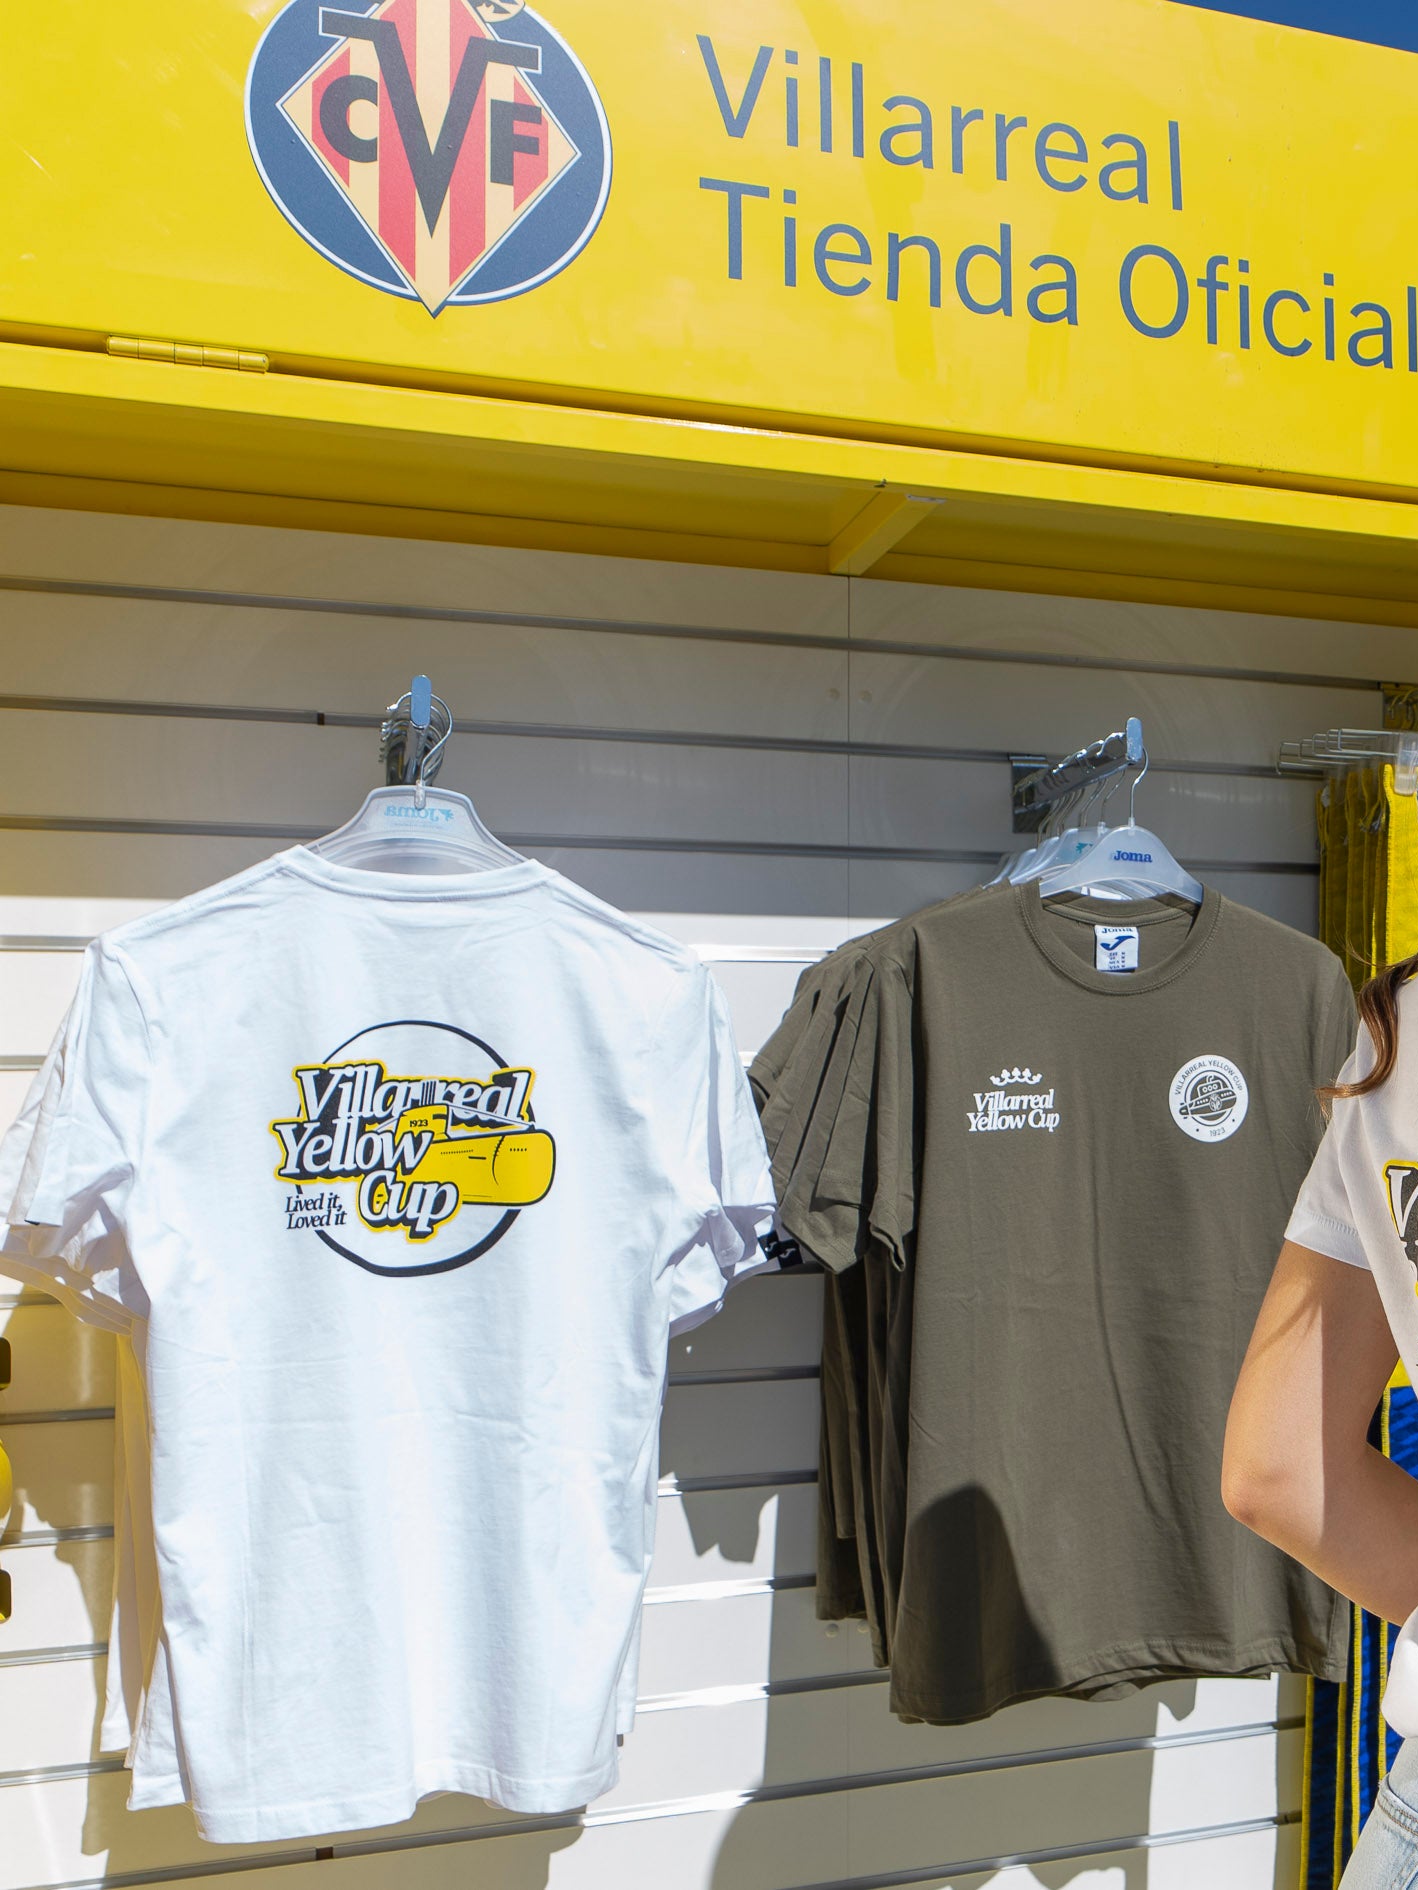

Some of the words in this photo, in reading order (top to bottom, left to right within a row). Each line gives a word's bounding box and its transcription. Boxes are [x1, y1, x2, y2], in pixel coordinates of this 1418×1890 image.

[695, 33, 1183, 211] Villarreal
[699, 177, 1079, 327] Tienda
[1119, 244, 1418, 373] Oficial
[1113, 850, 1153, 863] Joma
[1174, 1060, 1208, 1096] VILLARREAL
[1207, 1059, 1236, 1077] YELLOW
[1232, 1075, 1244, 1092] CUP
[296, 1063, 531, 1123] Villarreal
[973, 1088, 1055, 1114] Villarreal
[408, 1119, 429, 1128] 1923
[966, 1110, 1026, 1132] Yellow
[1027, 1107, 1060, 1132] Cup
[1209, 1127, 1226, 1137] 1923
[274, 1114, 435, 1176] Yellow
[284, 1192, 325, 1213] Lived
[327, 1192, 343, 1212] it,
[358, 1170, 458, 1233] Cup
[286, 1210, 331, 1230] Loved
[334, 1210, 348, 1226] it
